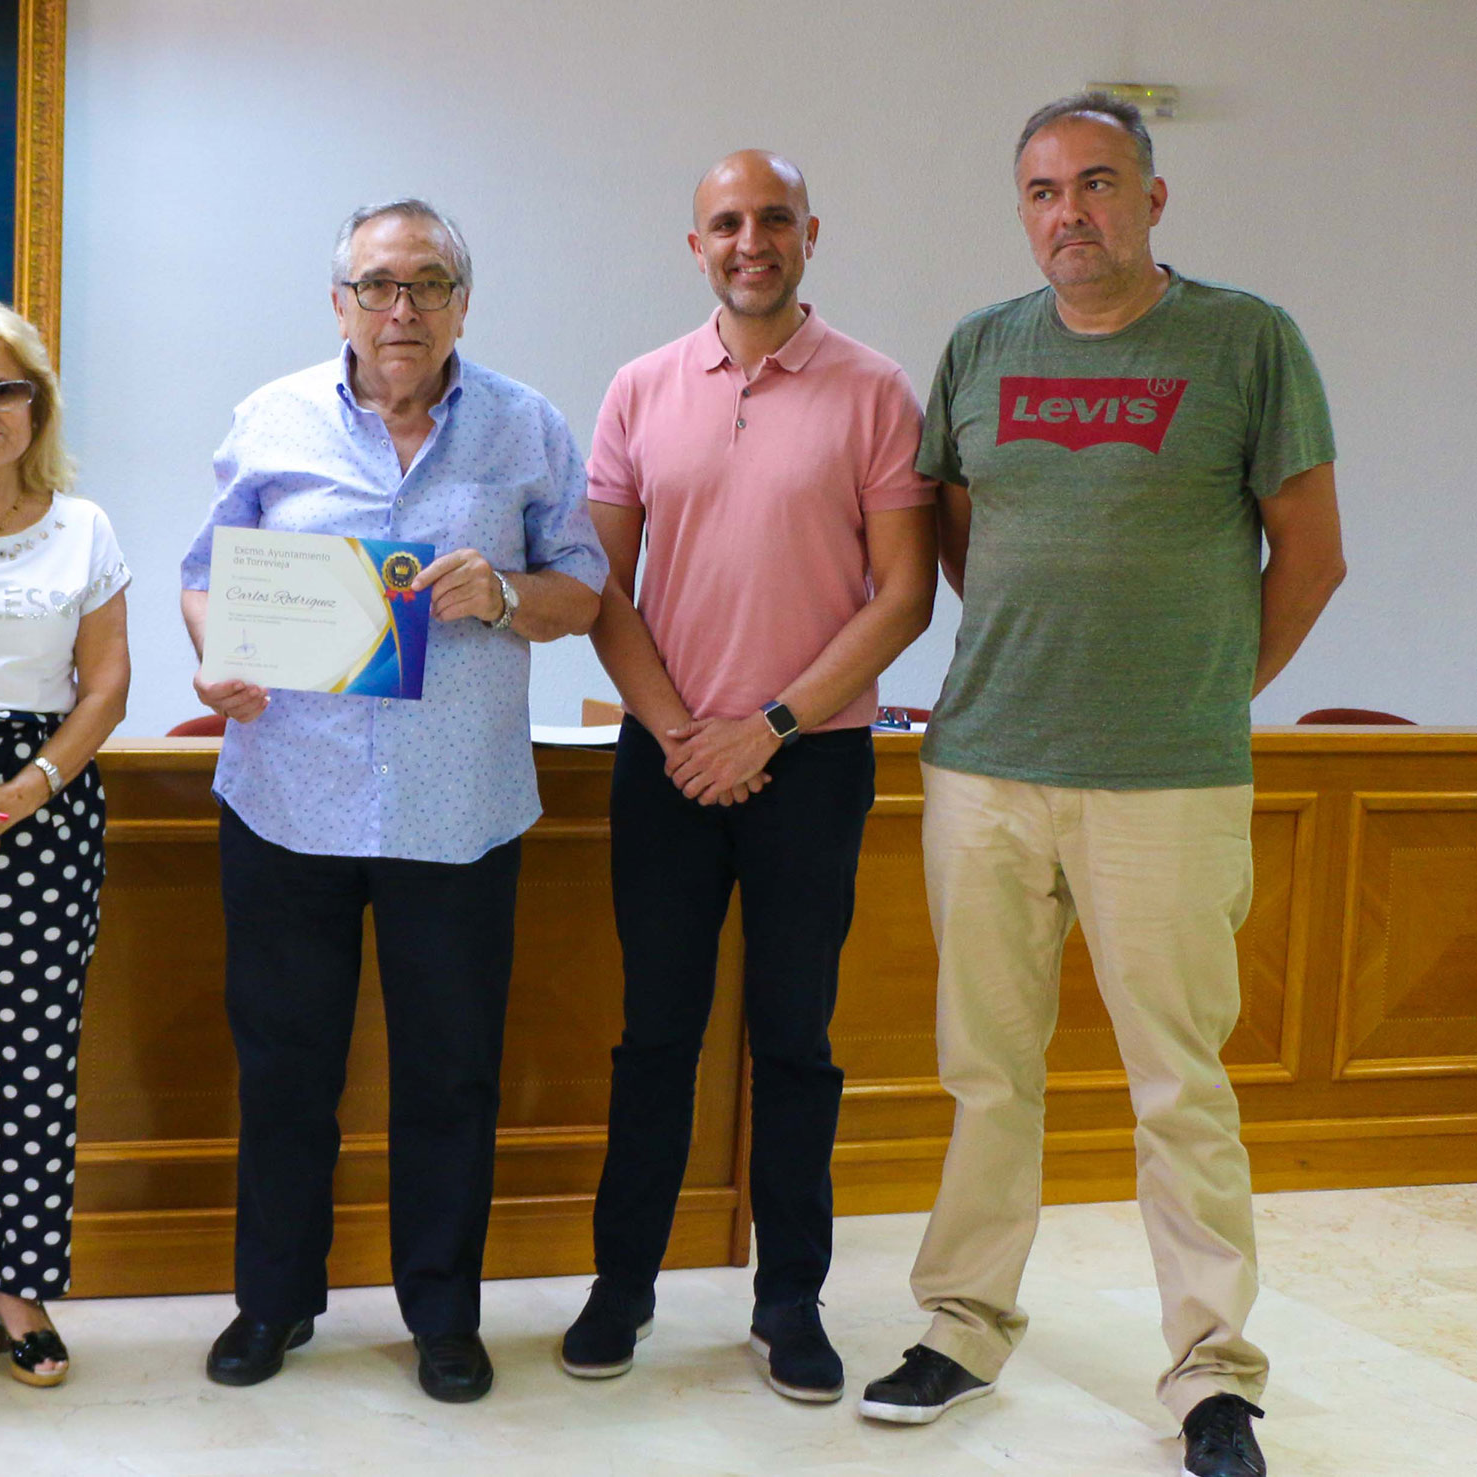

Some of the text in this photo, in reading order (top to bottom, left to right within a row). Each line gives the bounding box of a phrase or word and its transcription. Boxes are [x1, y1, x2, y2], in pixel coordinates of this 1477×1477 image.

[268, 548, 331, 562] Ayuntamiento
[233, 556, 290, 569] de Torrevieja
[225, 586, 270, 602] Carlos
